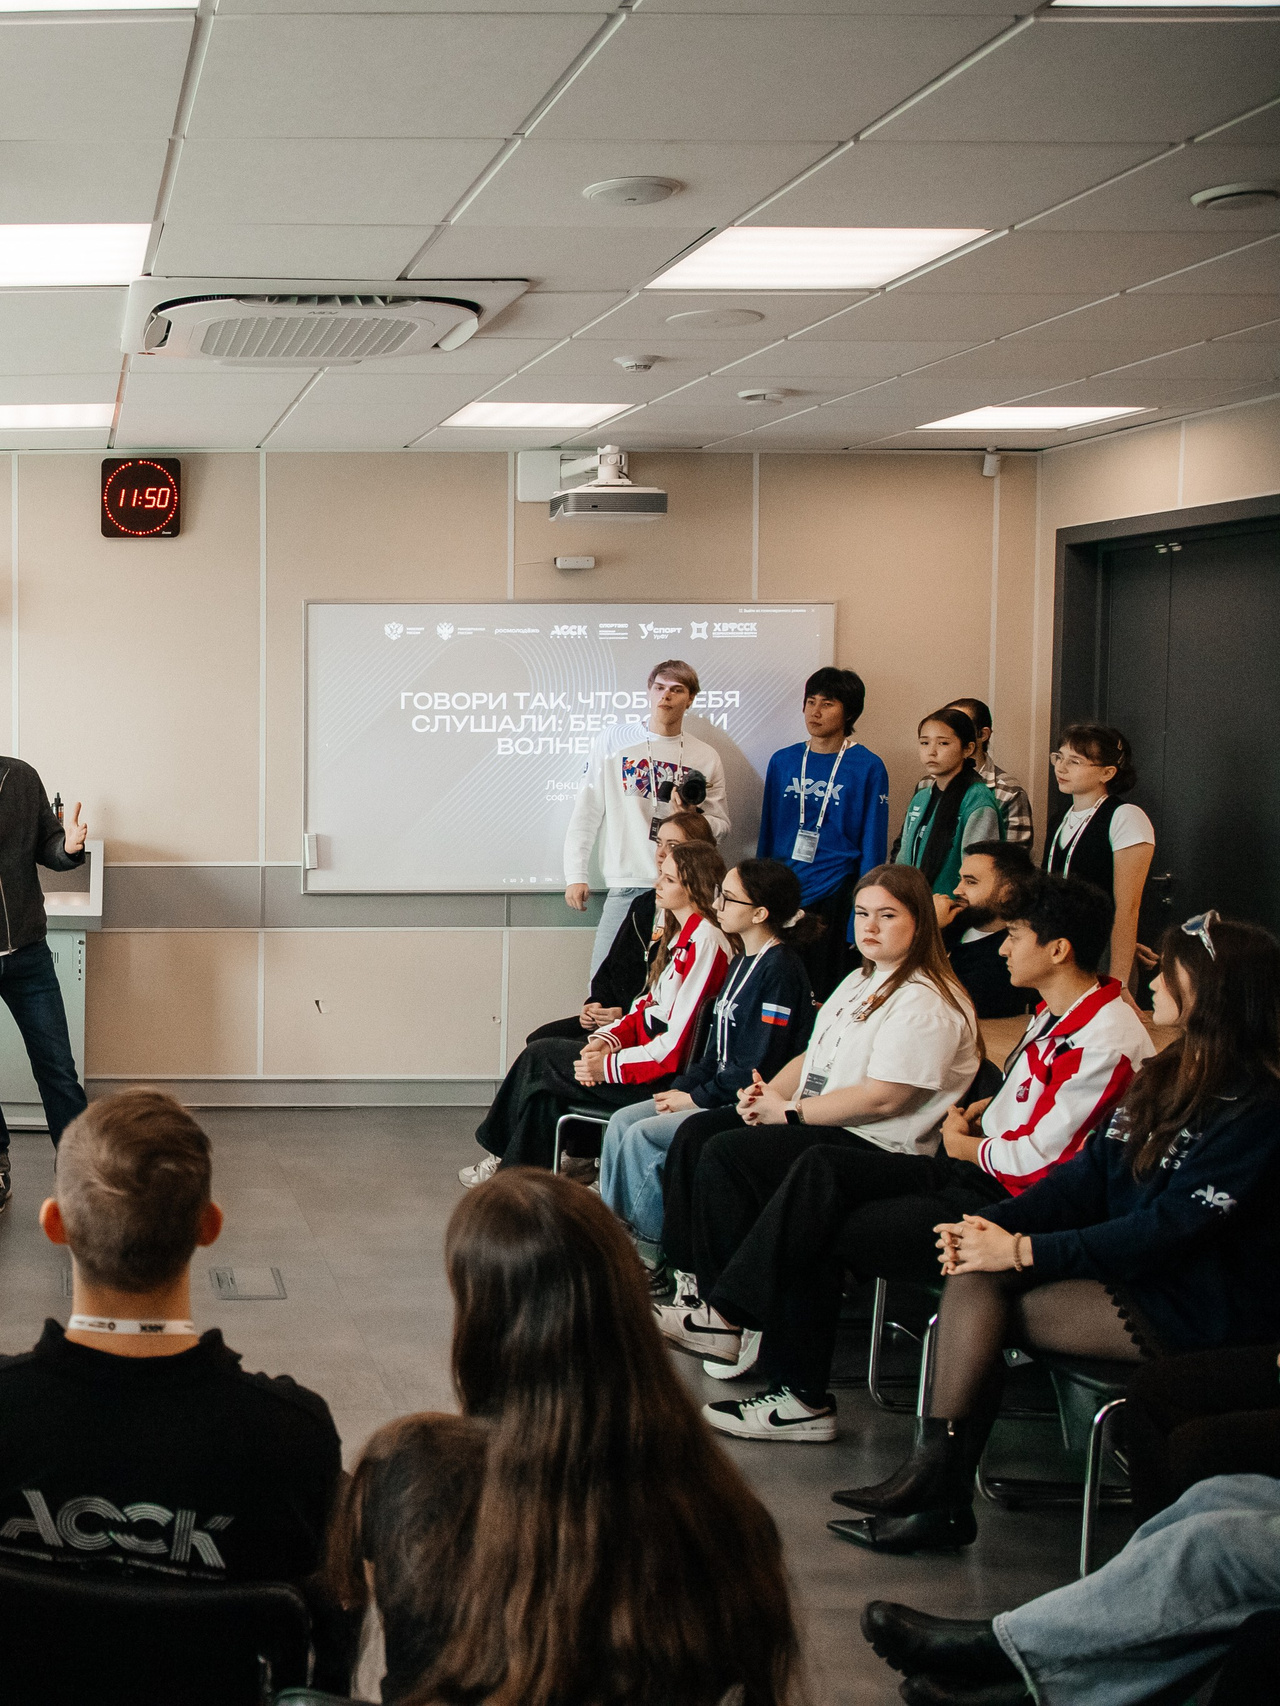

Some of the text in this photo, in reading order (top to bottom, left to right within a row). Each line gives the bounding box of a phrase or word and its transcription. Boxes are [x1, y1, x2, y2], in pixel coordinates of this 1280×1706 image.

[119, 487, 170, 508] 11:50
[400, 691, 740, 712] ГОВОРИ ТАК, ЧТОБ ЕБЯ
[411, 714, 563, 733] СЛУШАЛИ:
[569, 713, 618, 732] БЕЗ
[496, 736, 595, 755] ВОЛНЕ
[545, 779, 579, 791] Лекц
[546, 793, 577, 803] софт-т
